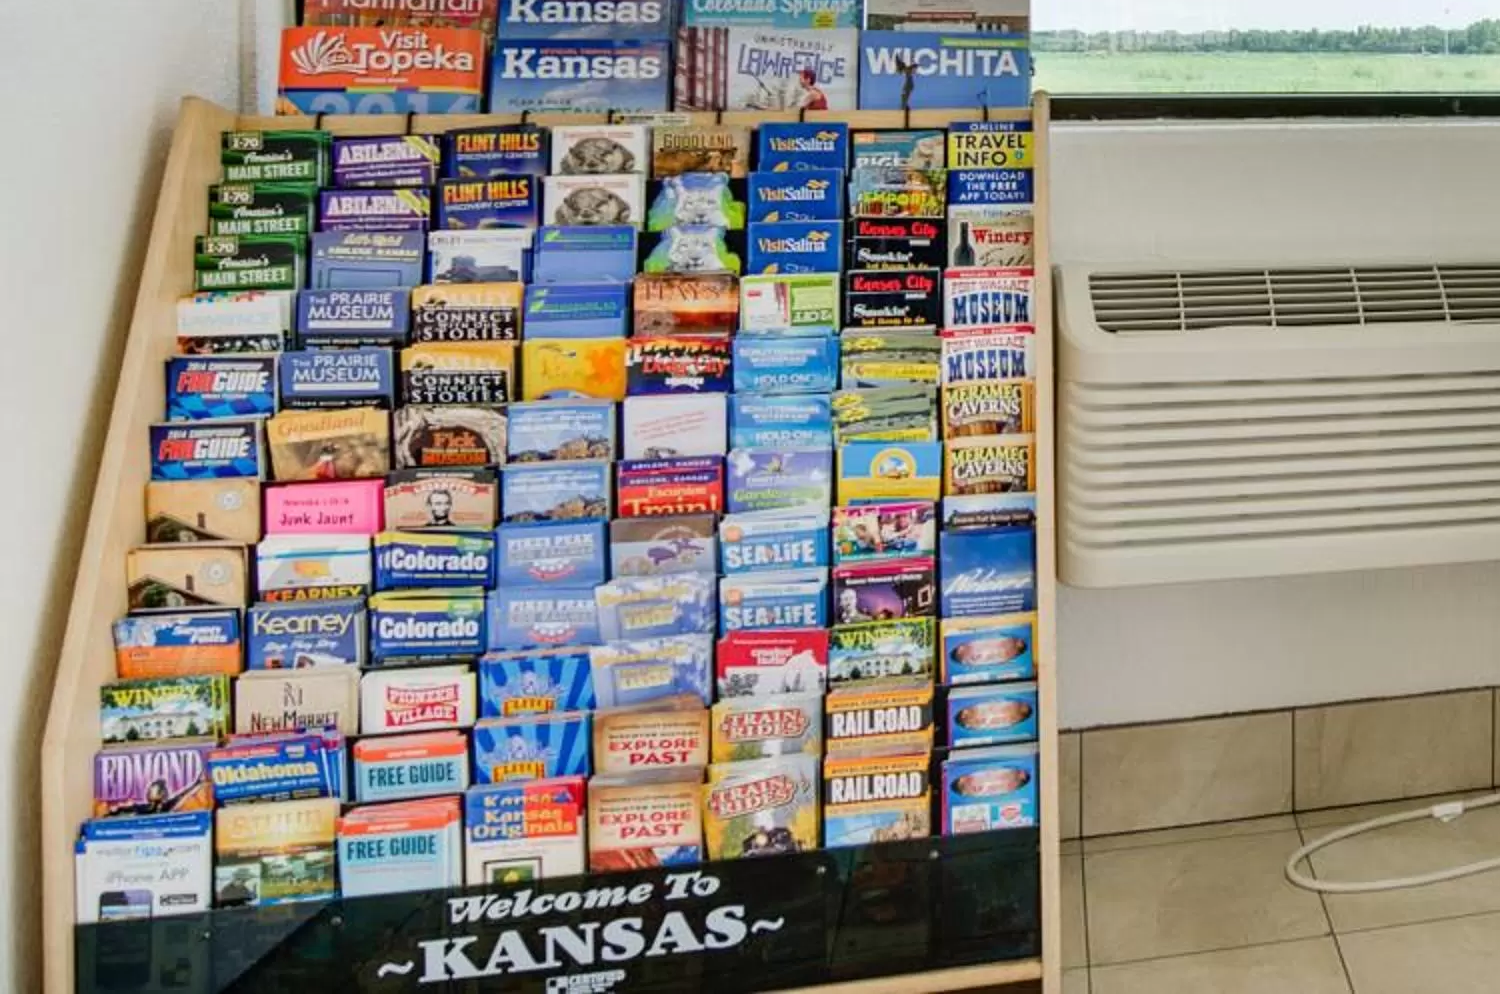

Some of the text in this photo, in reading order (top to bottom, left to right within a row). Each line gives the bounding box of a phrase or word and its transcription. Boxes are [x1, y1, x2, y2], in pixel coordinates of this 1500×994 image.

[380, 30, 429, 49] Visit
[352, 43, 475, 75] Topeka
[502, 48, 660, 79] Kansas
[737, 43, 846, 85] LAWRENCE
[866, 46, 1020, 77] WICHITA
[232, 136, 259, 148] I-70
[457, 133, 539, 152] FLINT HILLS
[663, 133, 734, 148] GOODLAND
[954, 135, 1025, 149] TRAVEL
[340, 143, 425, 165] ABILENE
[956, 151, 1007, 166] INFO
[229, 162, 310, 180] MAIN STREET
[959, 171, 1025, 181] DOWNLOAD
[444, 180, 528, 203] FLINT HILLS
[967, 182, 1017, 190] THE FREE
[222, 192, 250, 204] I-70
[327, 194, 411, 216] ABILENE
[959, 192, 978, 201] APP
[218, 218, 300, 234] MAIN STREET
[859, 222, 939, 238] Kansas City
[973, 229, 1033, 246] Winery
[207, 242, 234, 253] I-70
[203, 268, 287, 286] MAIN STREET
[854, 276, 934, 291] Kansas City
[329, 292, 393, 305] PRAIRIE
[308, 307, 393, 319] MUSEUM
[423, 310, 512, 322] CONNECT
[953, 293, 1029, 325] MUSEUM
[424, 326, 514, 340] STORIES
[314, 354, 378, 367] PRAIRIE
[949, 349, 1025, 384] MUSEUM
[212, 371, 269, 391] GUIDE
[293, 367, 381, 382] MUSEUM
[411, 373, 501, 386] CONNECT
[412, 390, 505, 403] STORIES
[949, 385, 1021, 402] MERAMEC
[949, 397, 1020, 416] CAVERNS
[194, 437, 250, 458] GUIDE
[953, 446, 1028, 462] MERAMEC
[954, 460, 1025, 478] CAVERNS
[280, 512, 355, 526] Junk Jaunt
[392, 548, 488, 571] Colorado
[725, 543, 767, 568] SEA
[266, 585, 362, 602] KEARNEY
[253, 611, 353, 636] Kearney
[726, 607, 768, 629] SEA
[379, 617, 479, 639] Colorado
[840, 628, 912, 648] WINERY
[113, 685, 198, 706] WINERY
[391, 705, 456, 725] VILLAGE
[727, 710, 802, 724] TRAIN
[833, 705, 921, 737] RAILROAD
[608, 737, 700, 751] EXPLORE
[628, 751, 692, 766] PAST
[101, 750, 202, 803] EDMOND
[213, 761, 319, 785] Oklahoma
[368, 761, 455, 788] FREE GUIDE
[711, 775, 785, 799] TRAIN
[831, 771, 921, 803] RAILROAD
[484, 808, 563, 823] Kansas
[600, 810, 692, 825] EXPLORE
[473, 820, 574, 840] Originals
[619, 824, 682, 839] PAST
[347, 834, 436, 860] FREE GUIDE
[449, 871, 721, 924] Welcome To
